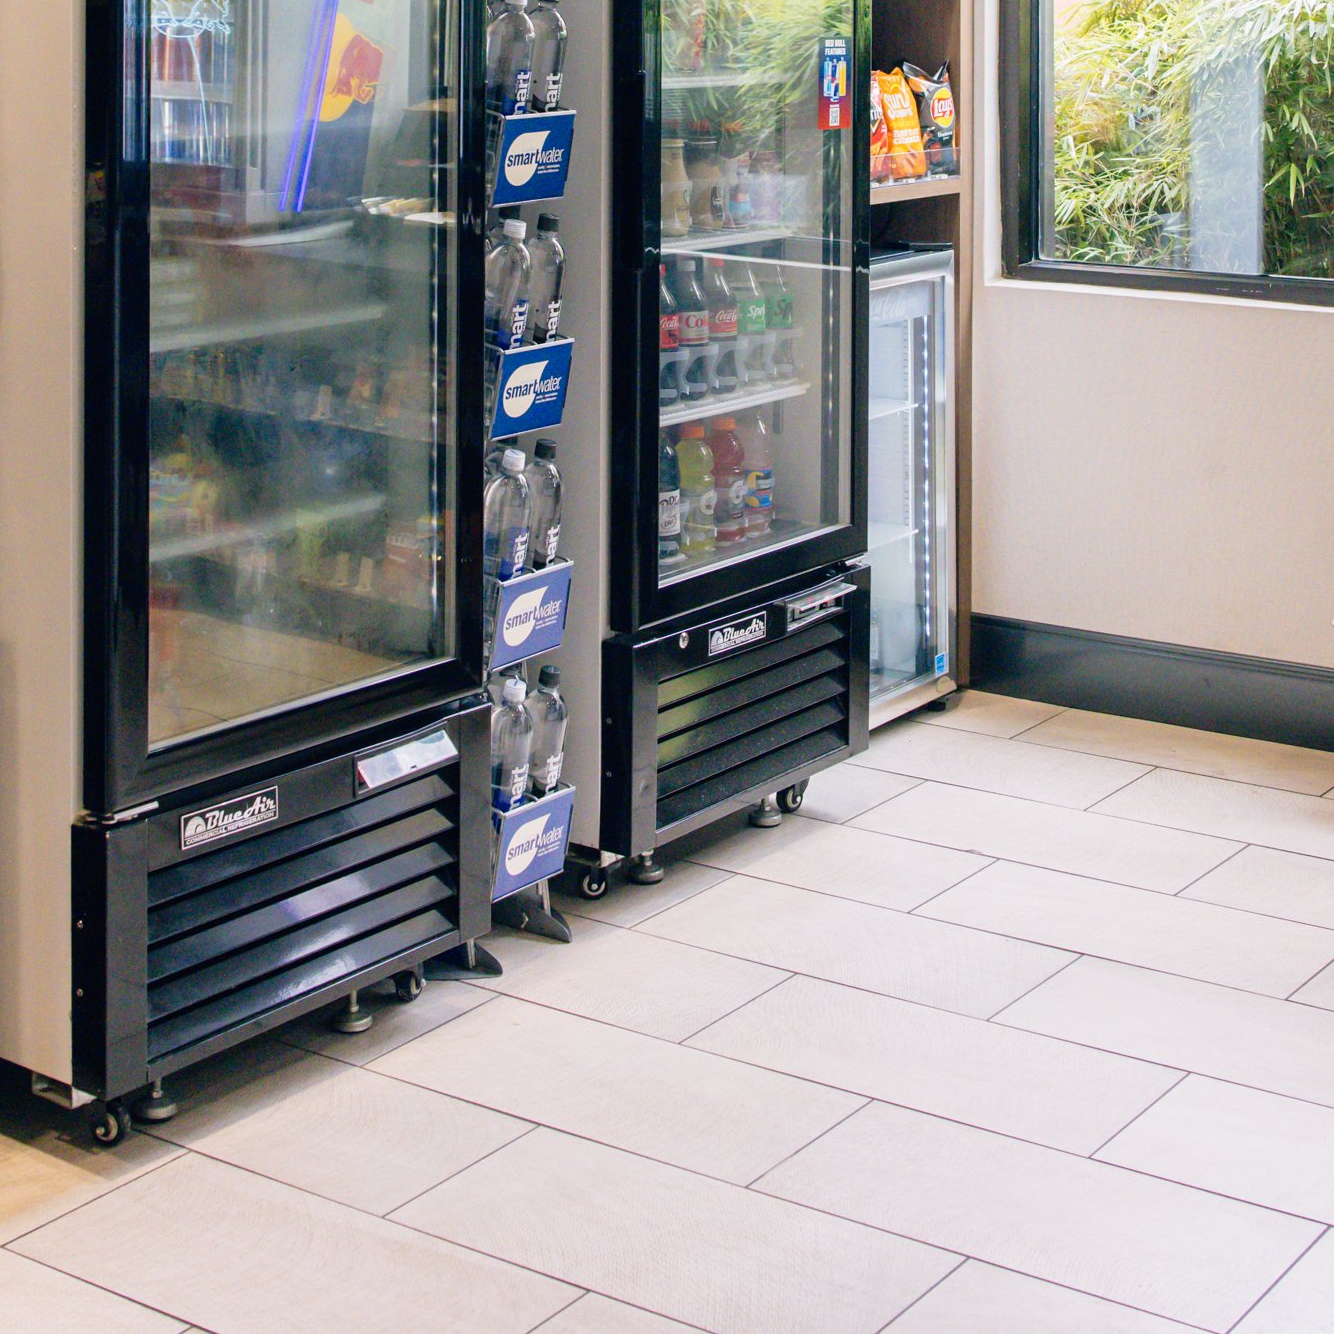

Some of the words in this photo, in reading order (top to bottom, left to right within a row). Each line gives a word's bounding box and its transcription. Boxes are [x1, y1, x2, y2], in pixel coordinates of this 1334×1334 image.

[507, 146, 564, 167] smartwater
[505, 375, 562, 401] smartwater
[505, 599, 562, 631] smartwater
[185, 826, 227, 846] COMMERCIAL
[226, 811, 275, 832] REFRIGERATION
[507, 825, 564, 862] smartwater
